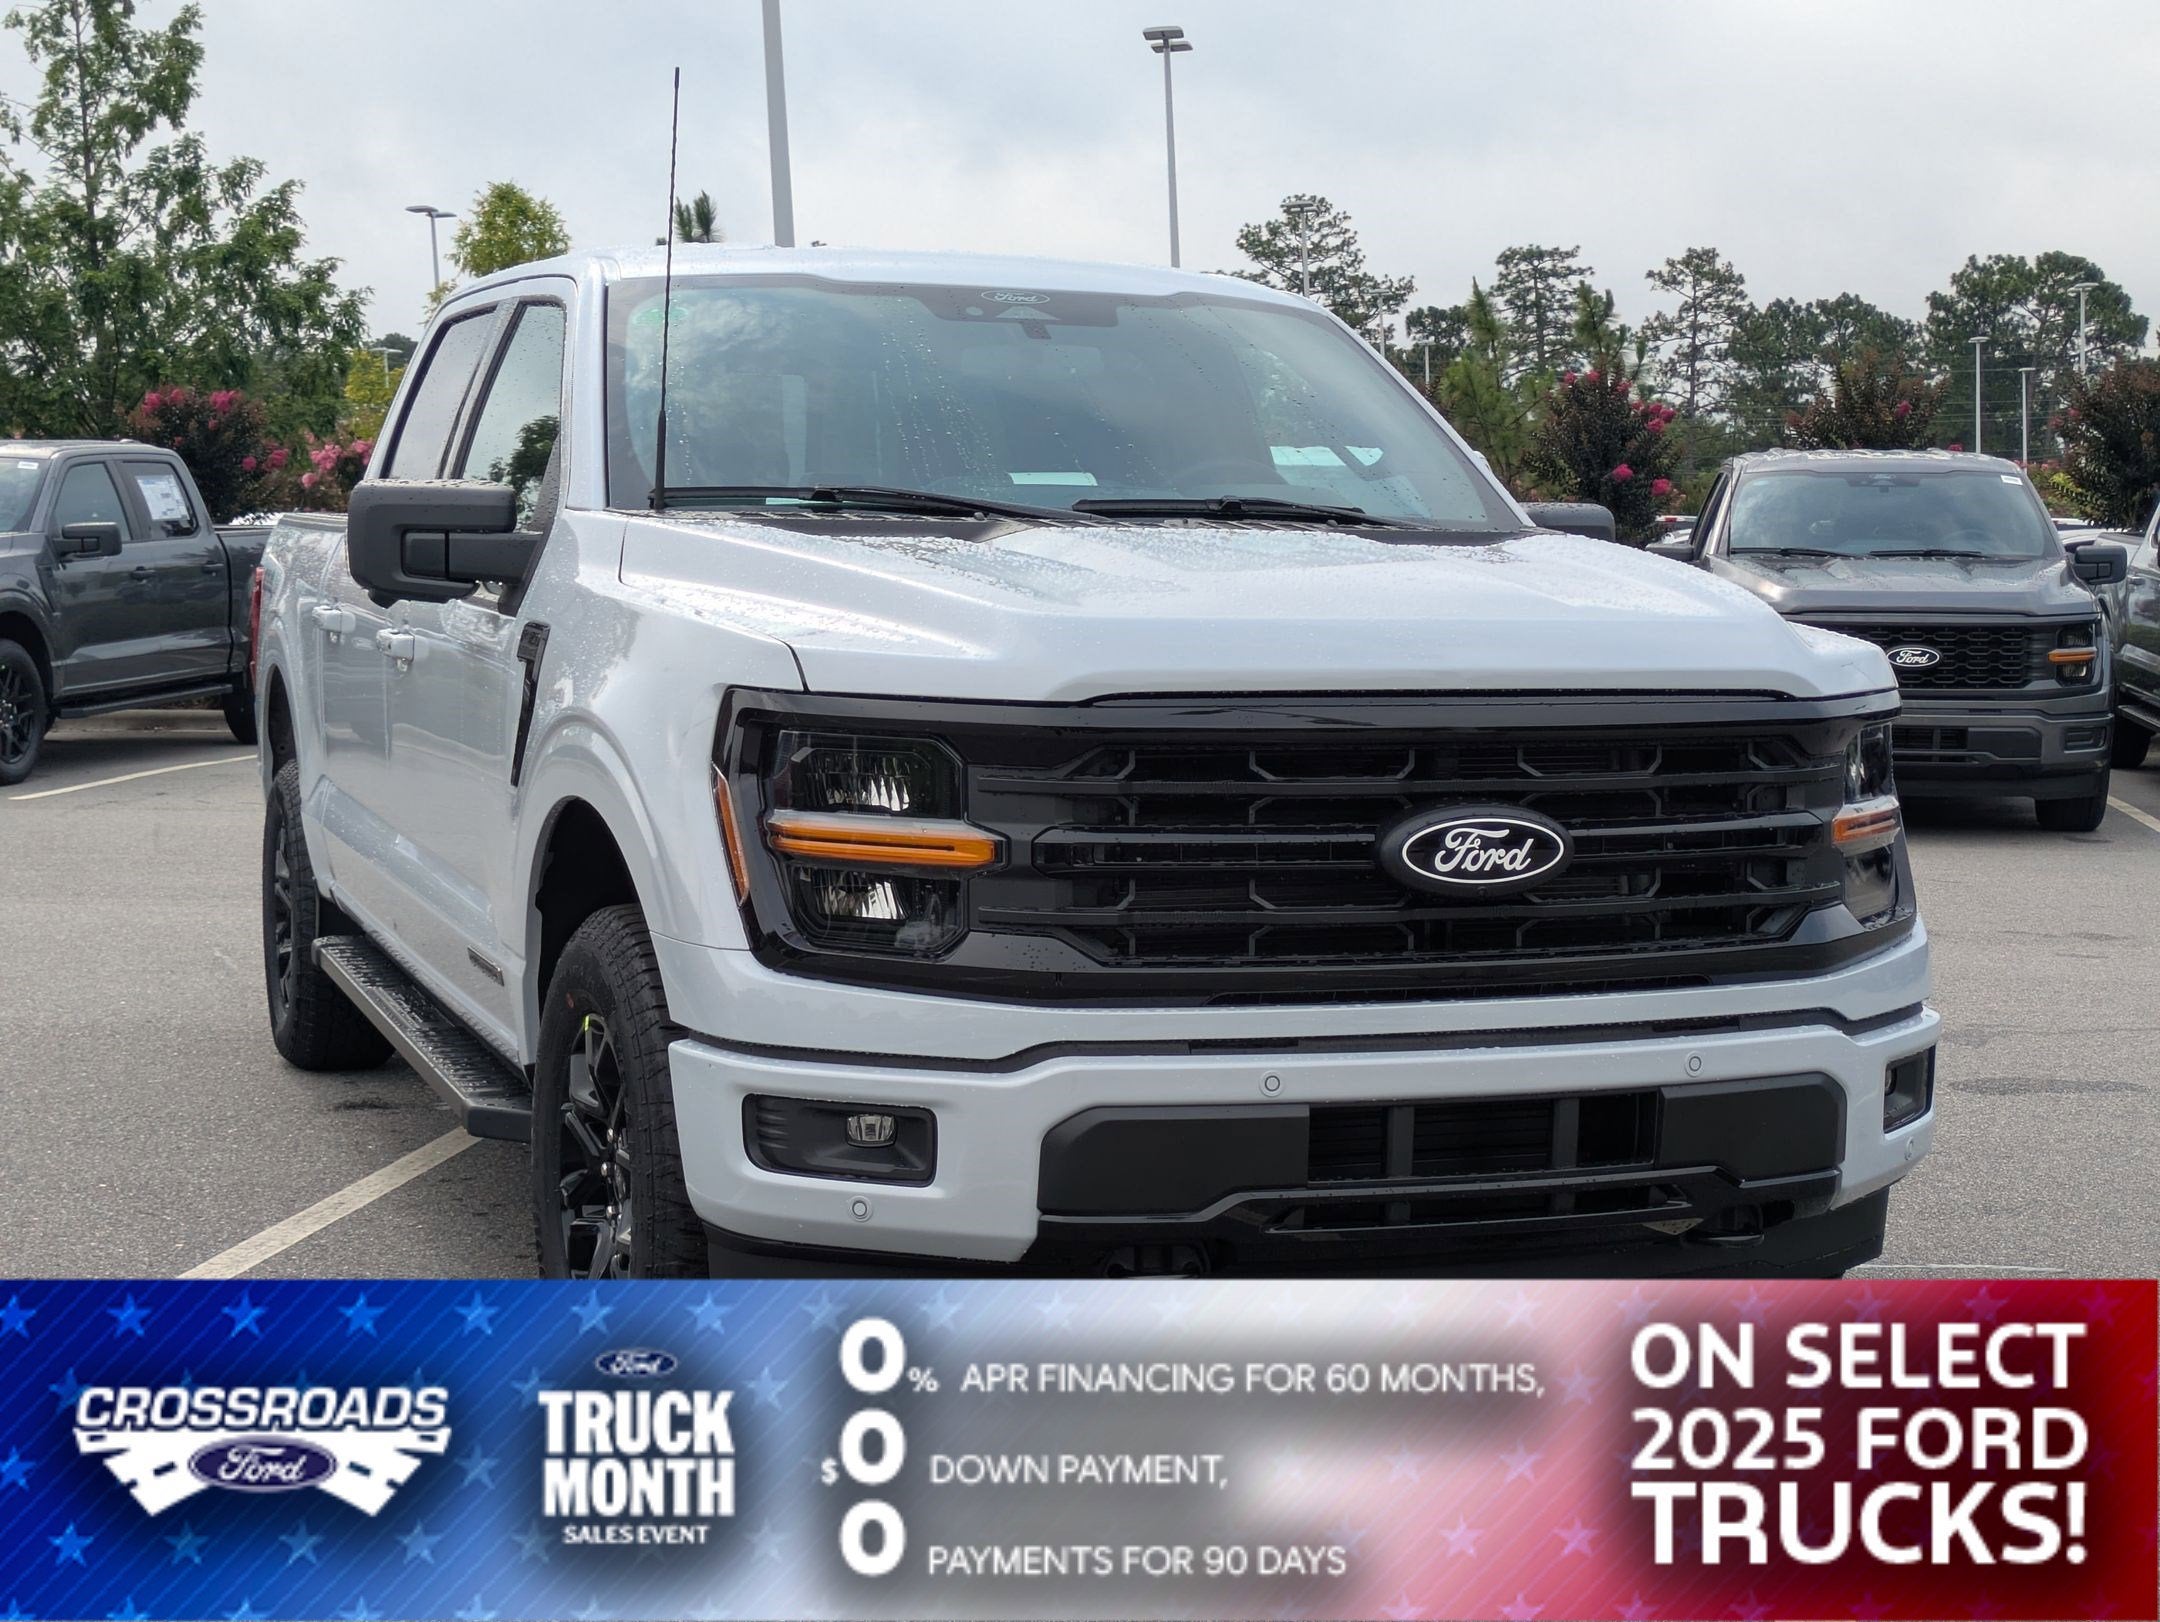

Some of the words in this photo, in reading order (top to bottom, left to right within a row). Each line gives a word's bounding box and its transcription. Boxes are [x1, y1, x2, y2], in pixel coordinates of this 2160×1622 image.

[993, 292, 1039, 303] Ford
[1896, 650, 1930, 663] Ford
[1434, 828, 1535, 872] Ford
